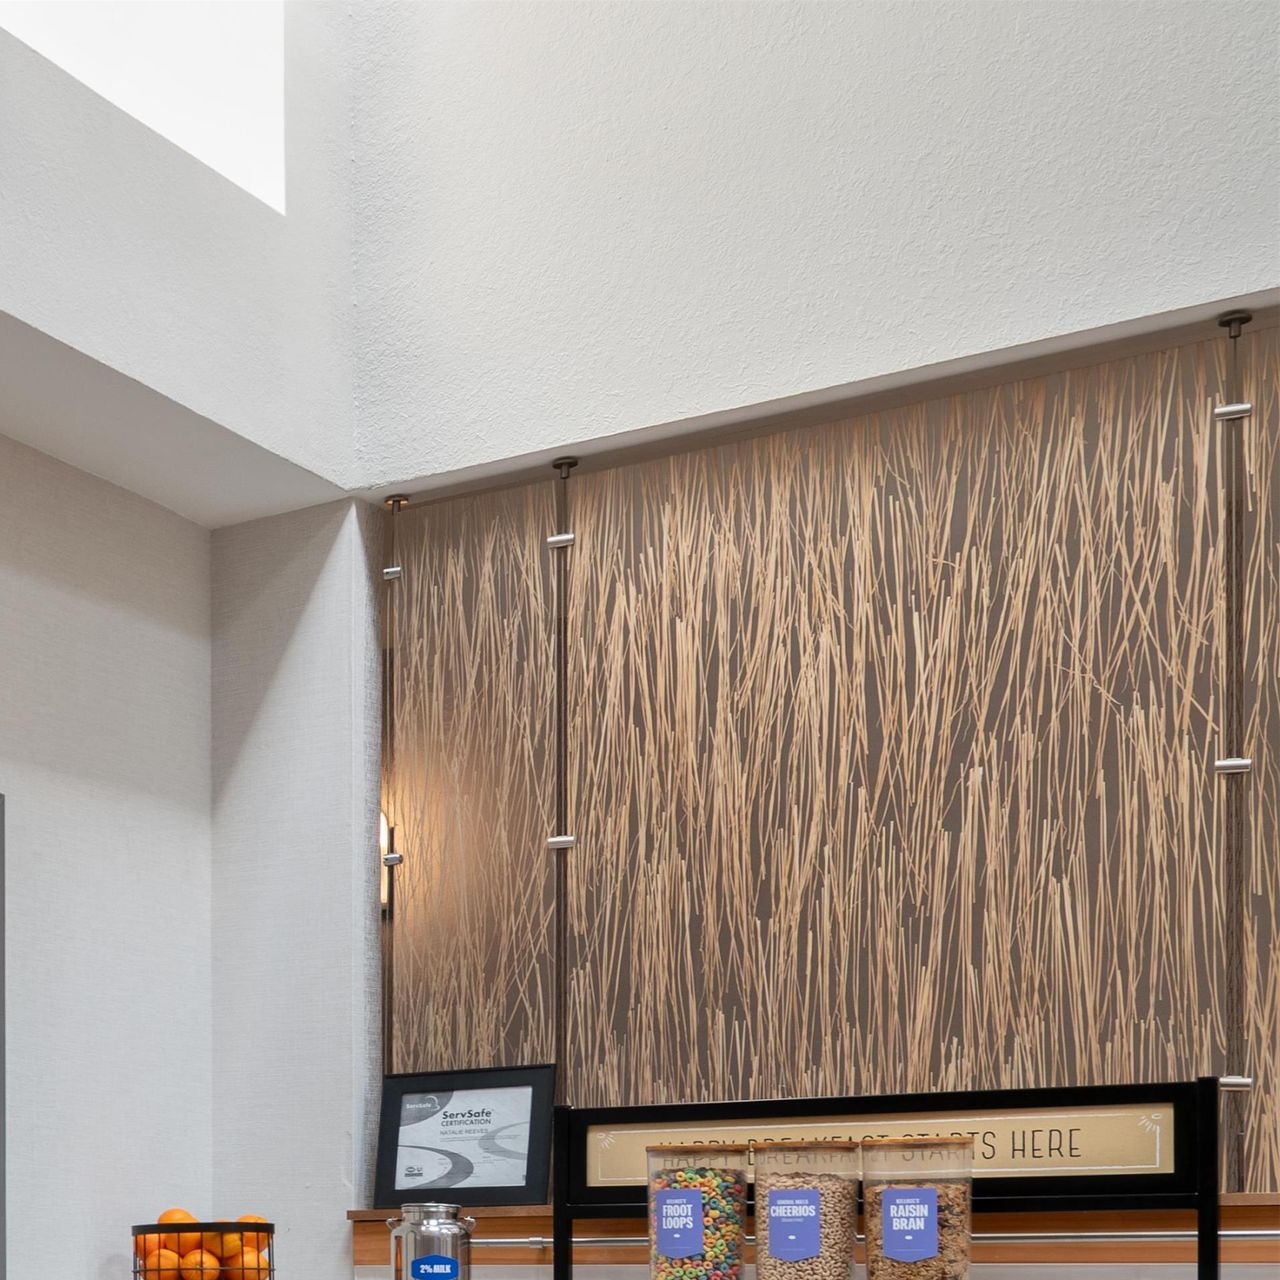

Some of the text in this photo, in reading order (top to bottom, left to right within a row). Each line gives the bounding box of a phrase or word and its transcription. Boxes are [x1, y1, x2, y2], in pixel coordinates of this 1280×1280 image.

[441, 1118, 492, 1127] CERTIFICATION
[1011, 1128, 1082, 1159] HERE
[662, 1204, 693, 1217] FROOT
[770, 1205, 816, 1217] CHEERIOS
[890, 1204, 929, 1217] RAISIN
[662, 1216, 694, 1229] LOOPS
[892, 1217, 925, 1230] BRAN
[419, 1264, 452, 1274] 2% MILK
